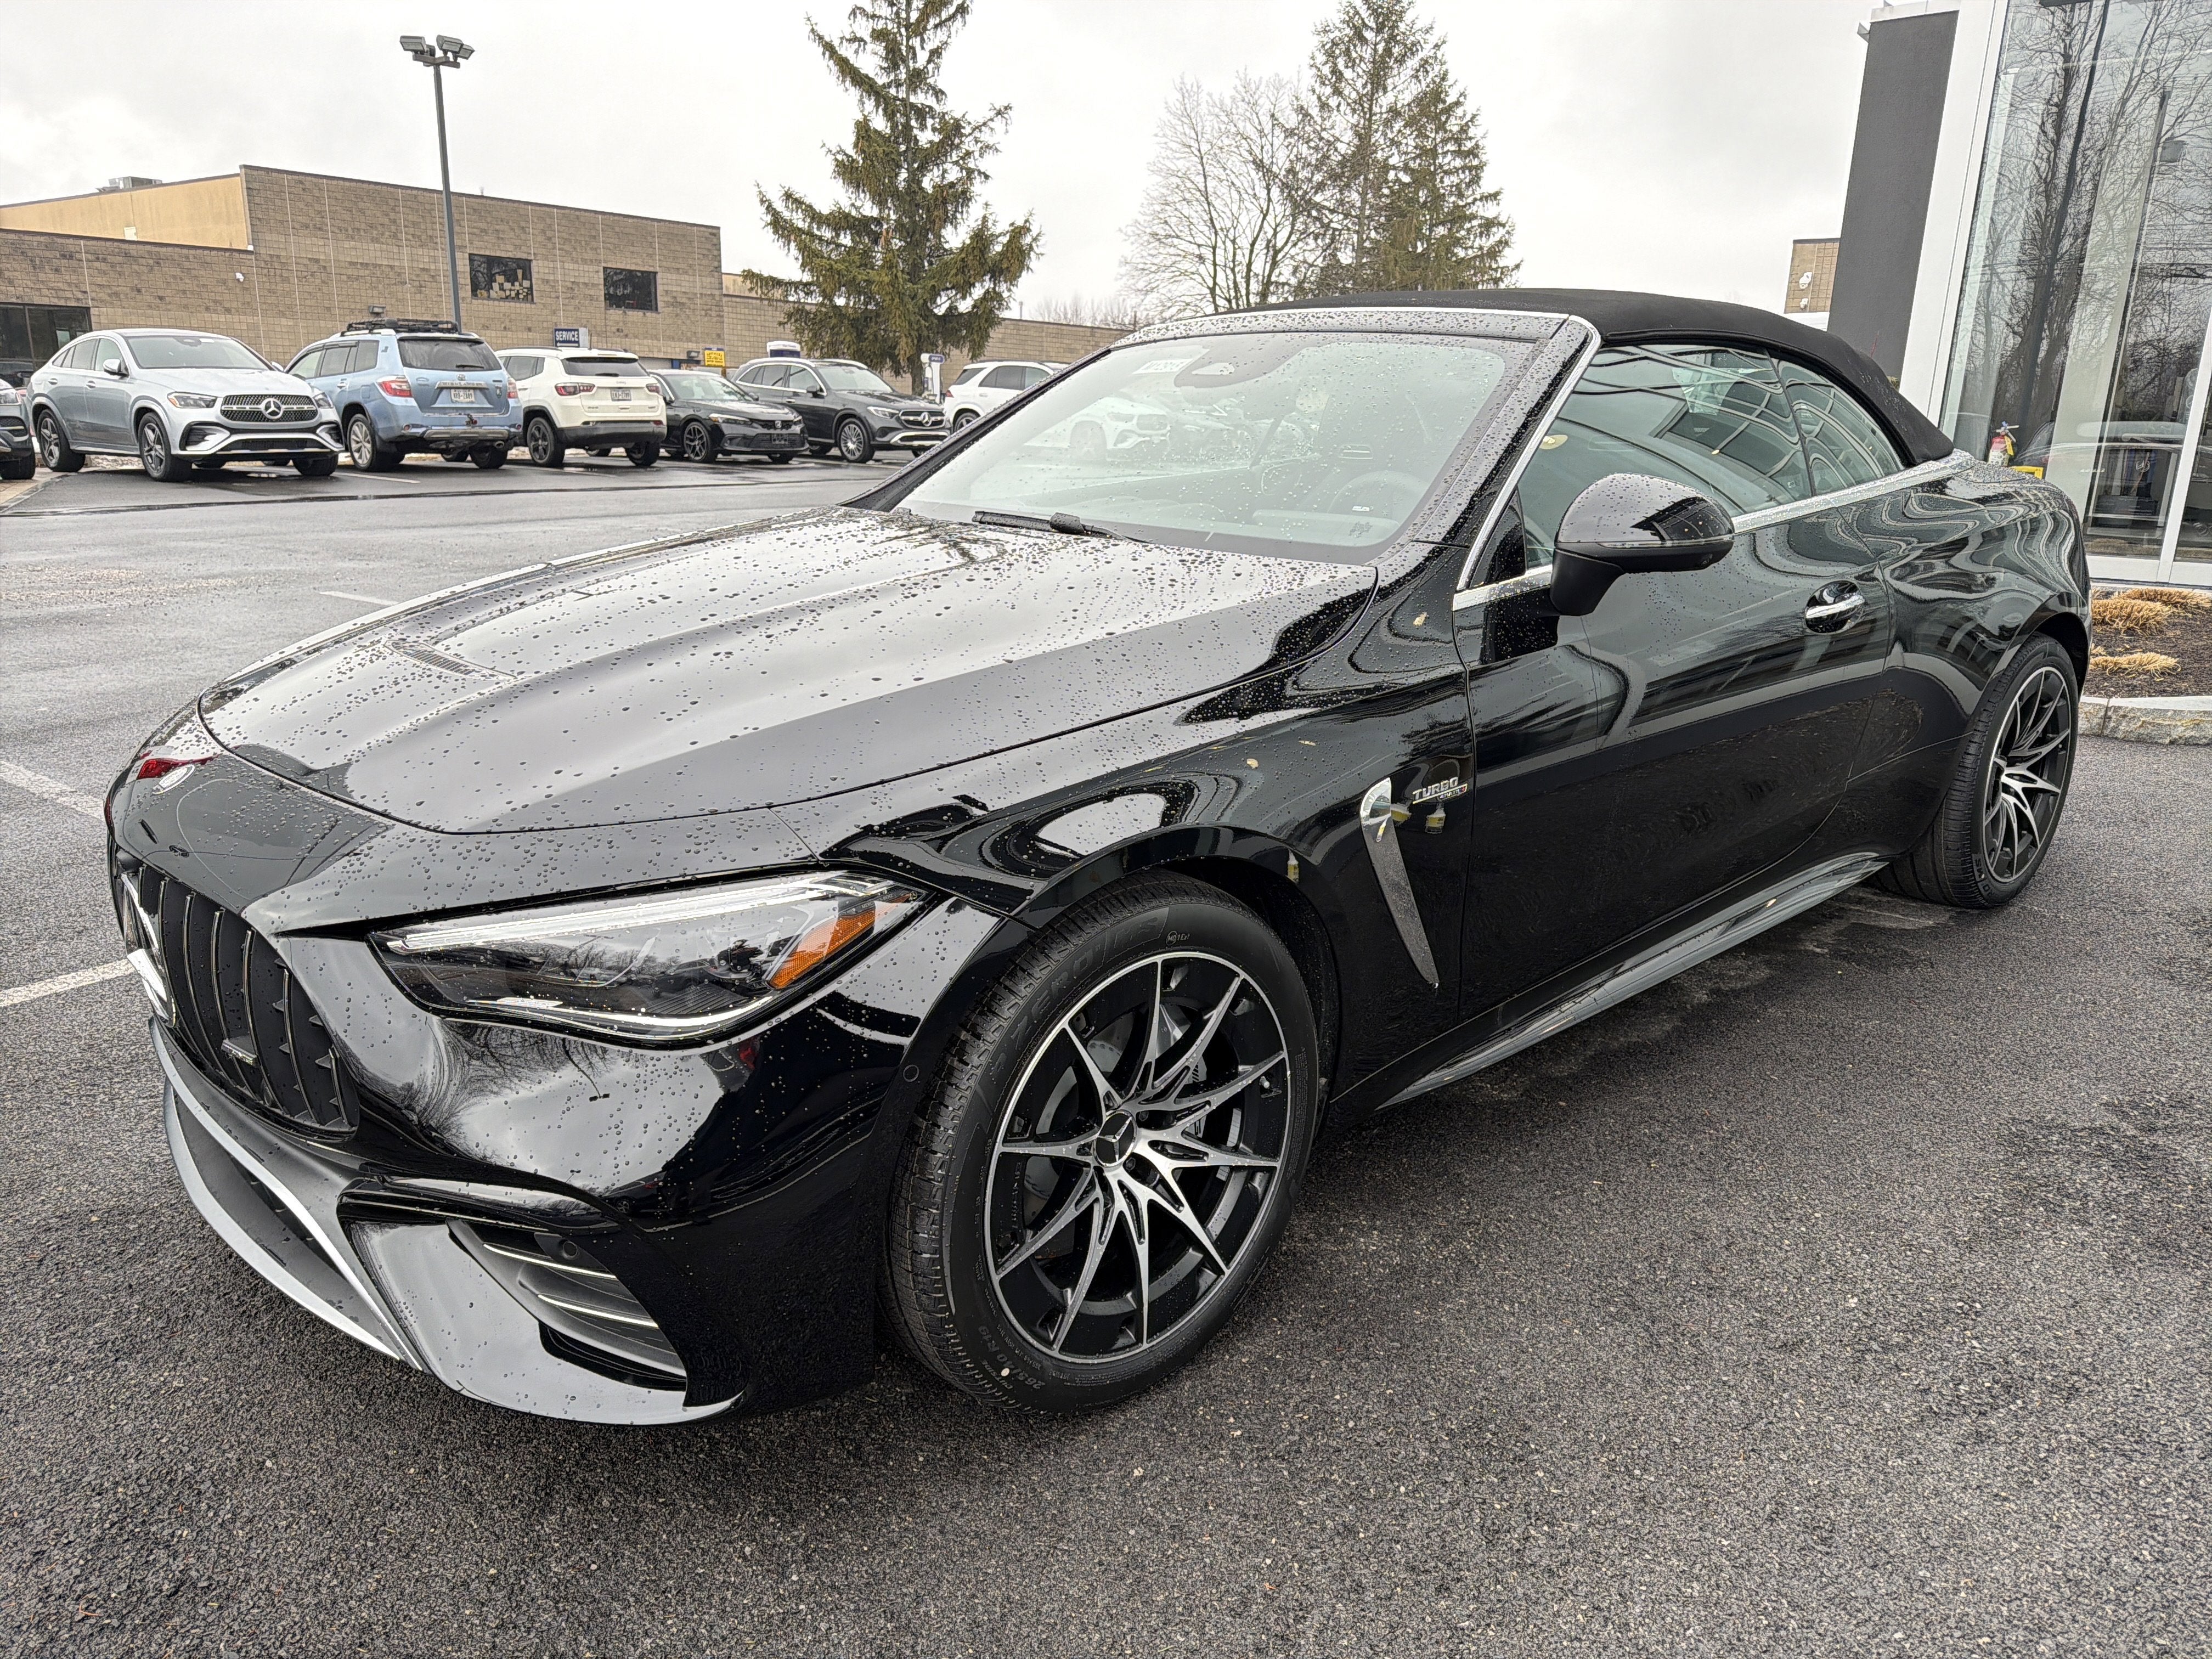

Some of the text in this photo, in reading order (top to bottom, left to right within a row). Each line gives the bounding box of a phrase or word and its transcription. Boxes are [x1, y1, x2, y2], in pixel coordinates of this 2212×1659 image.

[555, 331, 579, 341] SERVICE
[1413, 776, 1458, 800] TURBO
[980, 1359, 1013, 1390] OUTSIDE
